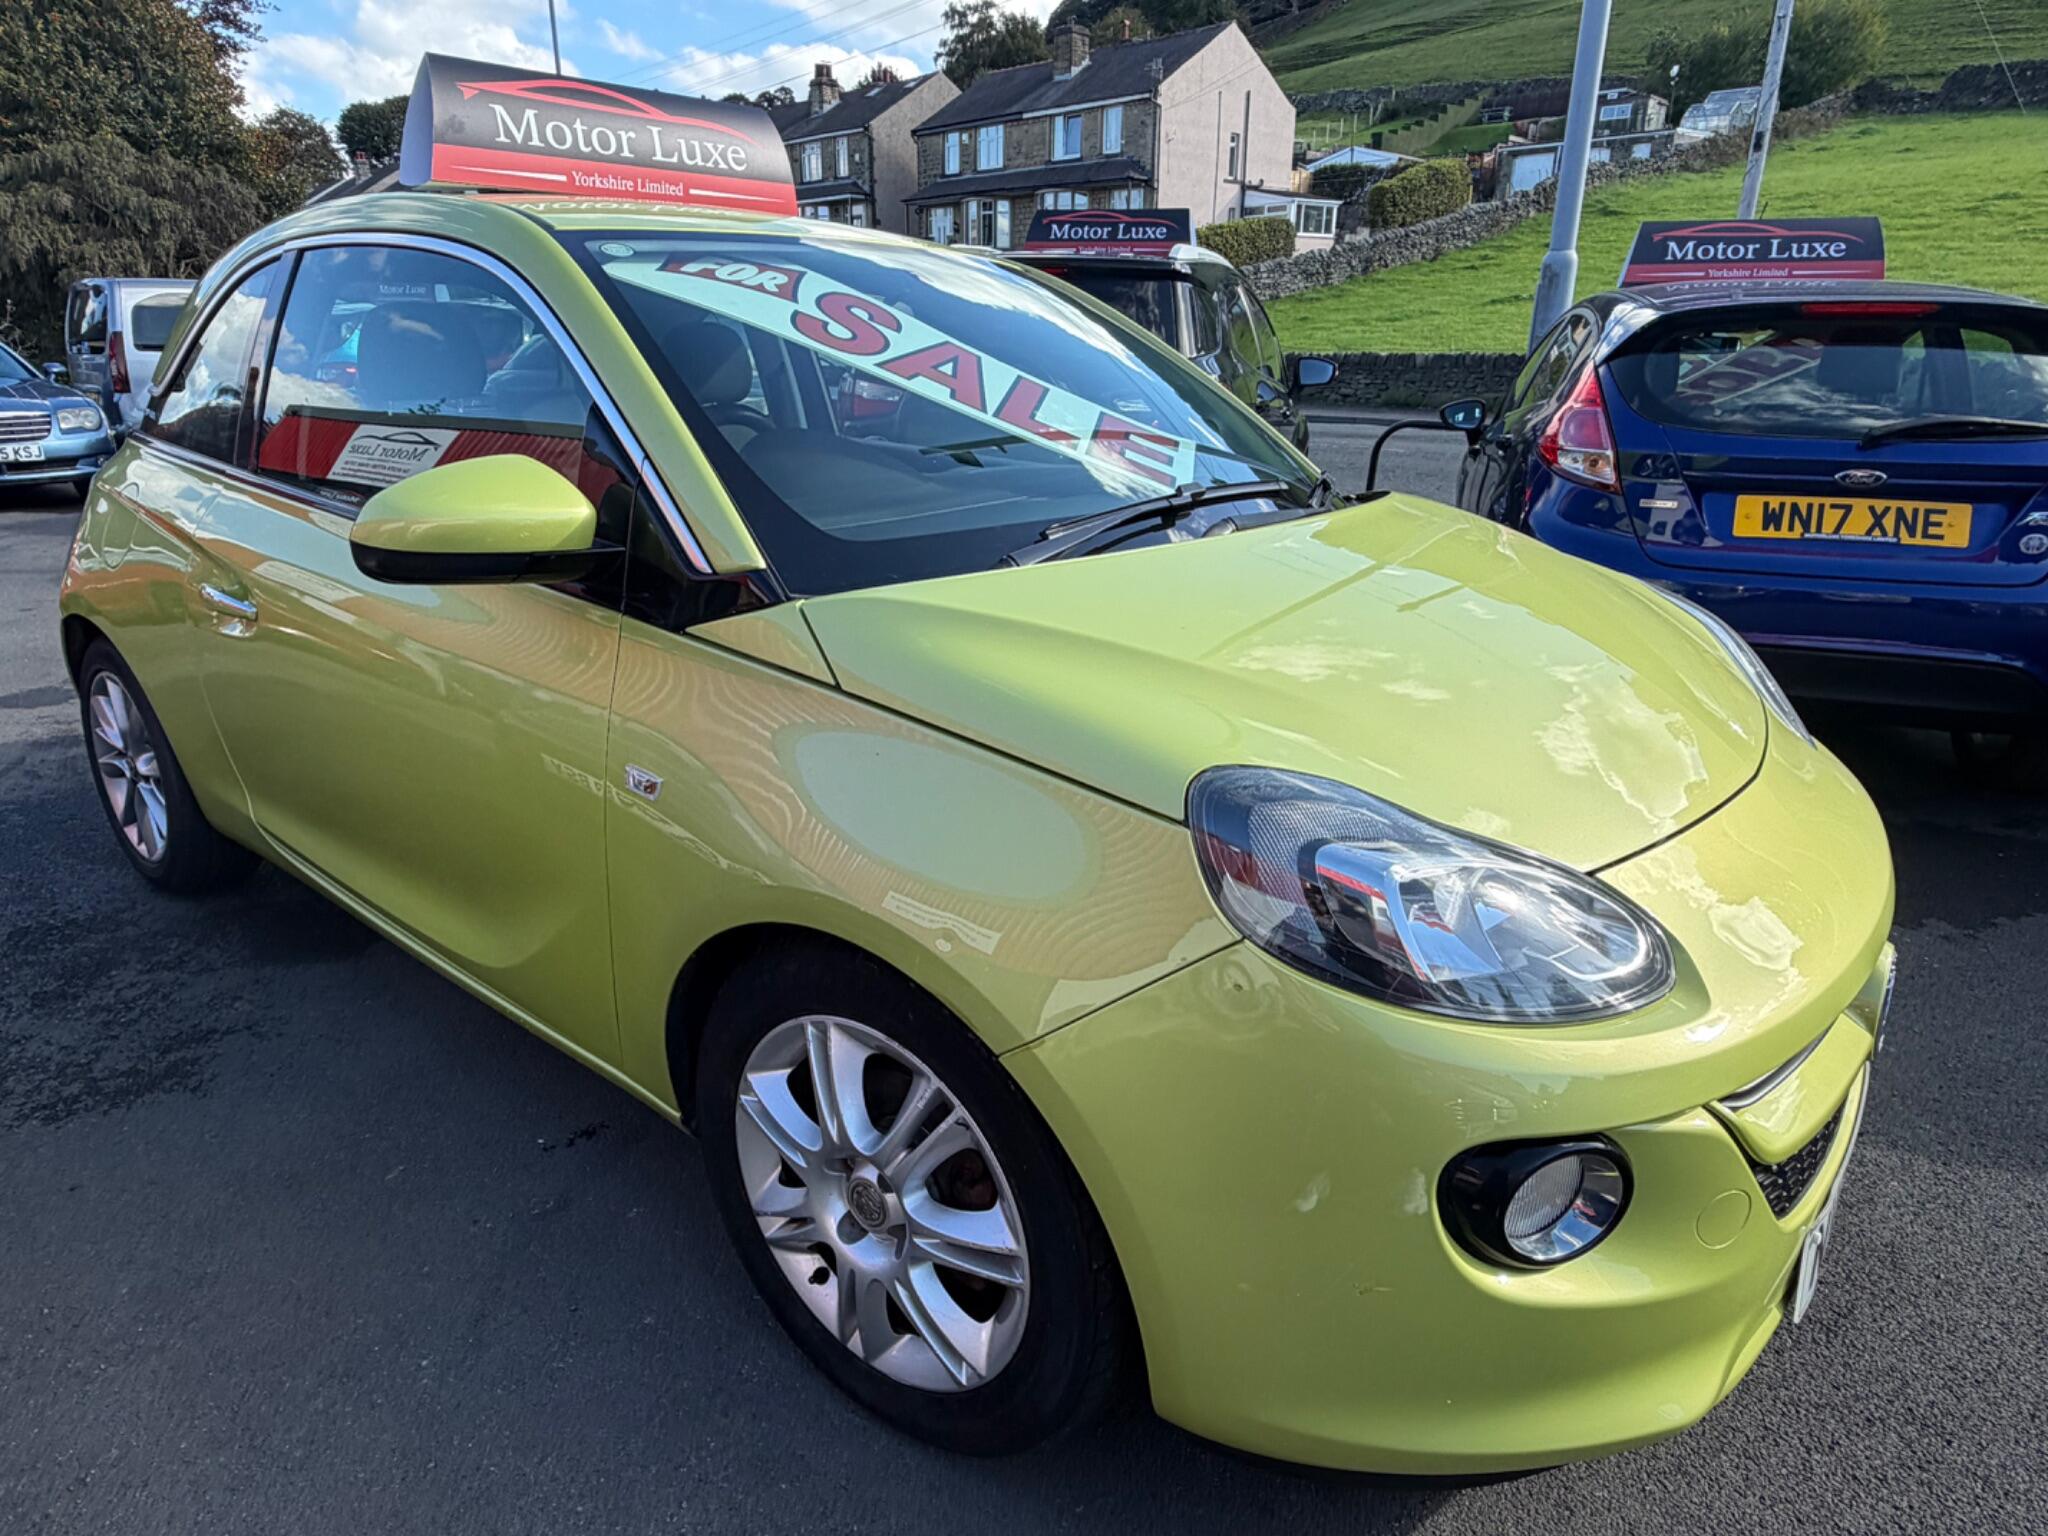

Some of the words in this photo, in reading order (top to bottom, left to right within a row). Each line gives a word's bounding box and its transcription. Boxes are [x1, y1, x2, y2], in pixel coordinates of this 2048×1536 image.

[489, 103, 637, 158] Motor
[647, 125, 748, 172] Luxe
[571, 170, 635, 192] Yorkshire
[637, 178, 685, 197] Limited
[1050, 223, 1111, 240] Motor
[1117, 223, 1168, 240] Luxe
[1665, 240, 1760, 261] Motor
[1768, 238, 1847, 259] Luxe
[1707, 268, 1751, 278] Yorkshire
[1752, 267, 1789, 277] Limited
[680, 256, 789, 292] FOR
[791, 291, 1180, 488] SALE
[12, 445, 43, 460] KSJ
[1762, 501, 1853, 535] WN17
[1865, 504, 1948, 540] XNE
